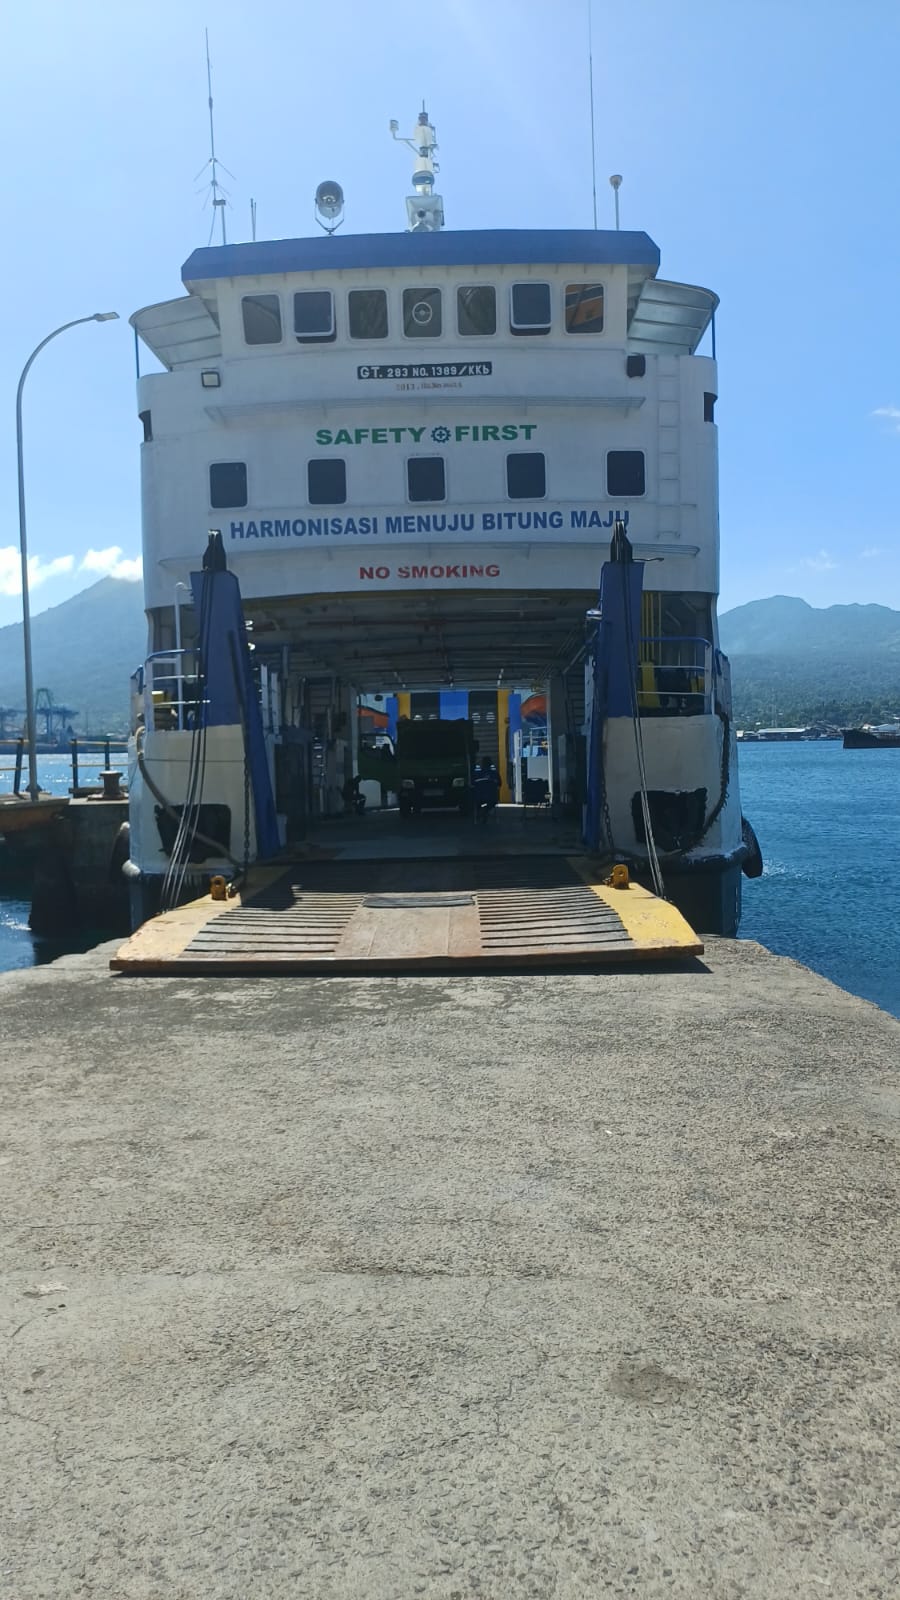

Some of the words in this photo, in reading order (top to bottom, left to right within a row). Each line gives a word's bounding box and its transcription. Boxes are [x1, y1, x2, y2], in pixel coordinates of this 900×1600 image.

[360, 366, 383, 378] GT.
[387, 367, 408, 377] 283
[316, 426, 426, 445] SAFETY
[455, 424, 538, 442] FIRST
[230, 517, 378, 539] HARMONISASI
[385, 513, 475, 534] MENUJU
[482, 511, 563, 531] BITUNG
[570, 510, 630, 529] MAJU
[359, 566, 390, 580] NO
[397, 564, 501, 579] SMOKING
